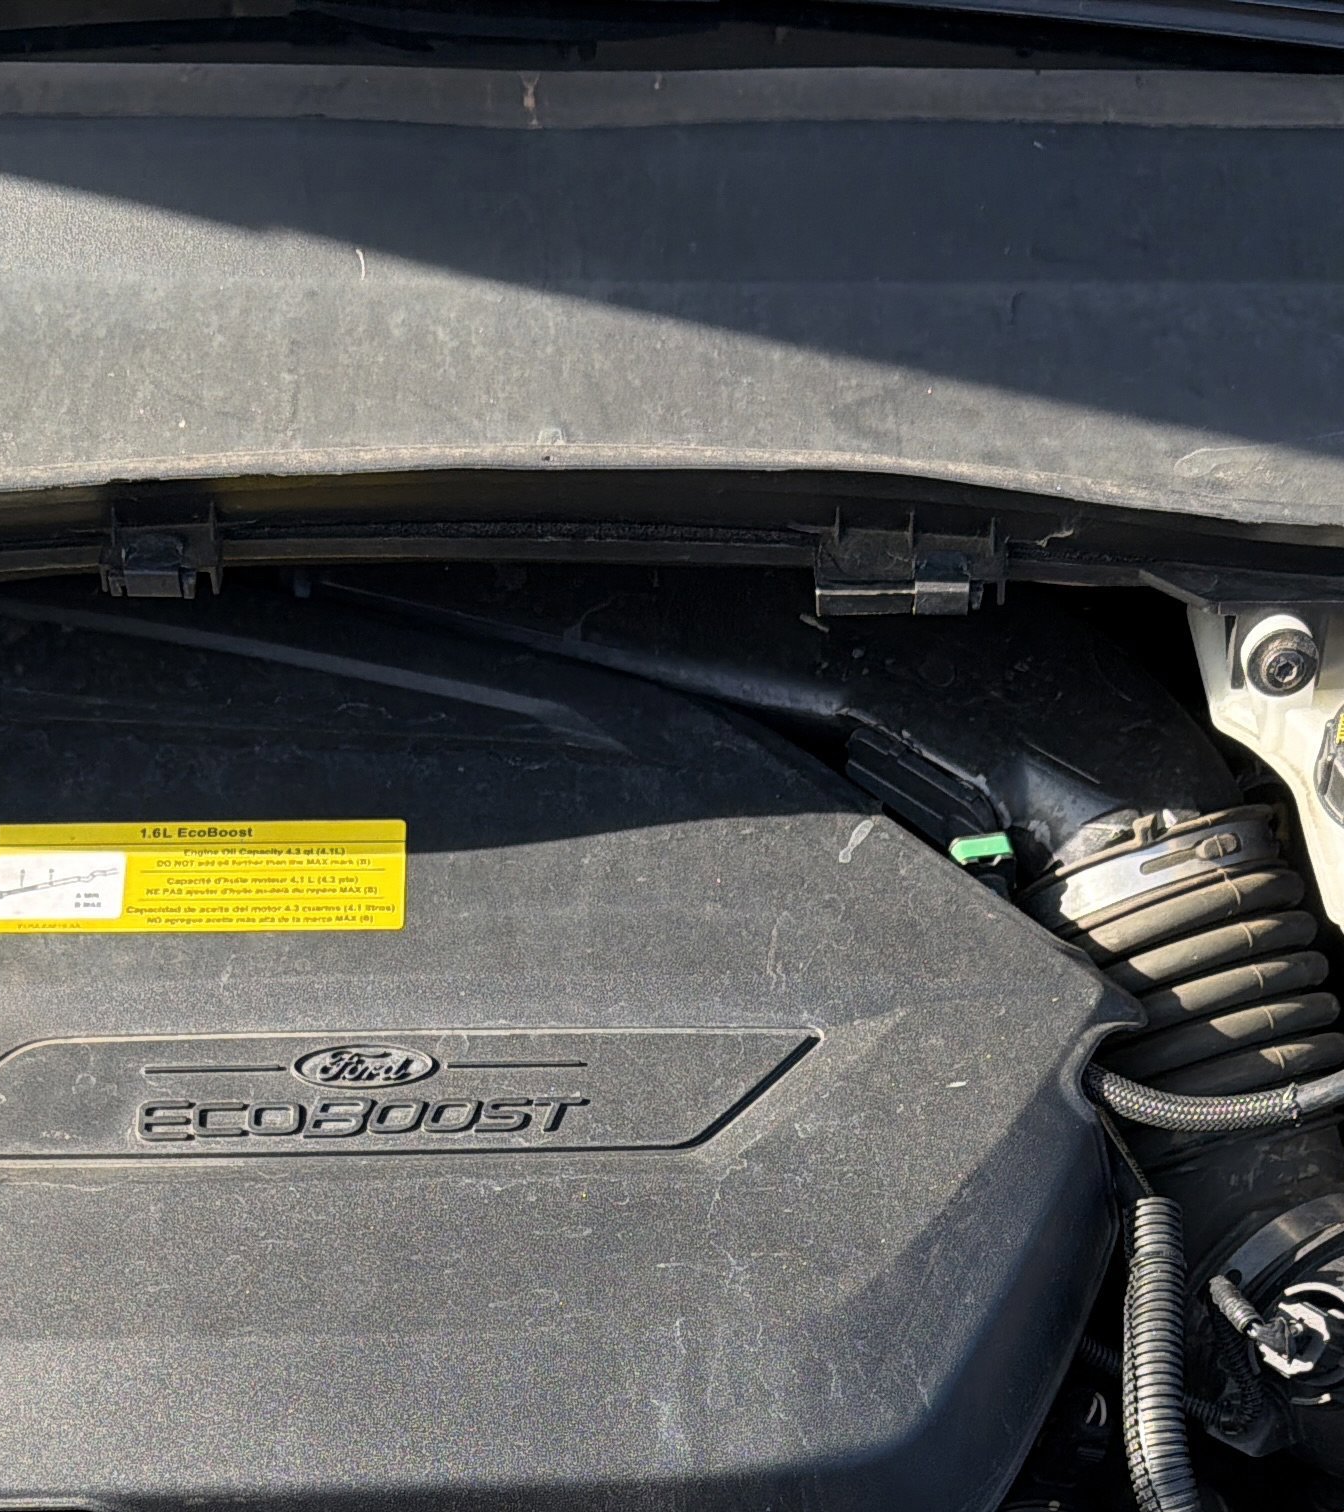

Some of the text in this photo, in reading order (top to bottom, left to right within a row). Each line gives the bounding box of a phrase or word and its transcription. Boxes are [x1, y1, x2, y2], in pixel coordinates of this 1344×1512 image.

[140, 826, 254, 840] 1.6L EcoBoost
[184, 848, 219, 857] Engine
[239, 848, 283, 856] Capacity
[198, 859, 215, 867] add
[331, 858, 354, 866] mark
[251, 877, 287, 885] moteur
[146, 888, 160, 896] NE
[163, 888, 182, 896] PAS
[126, 905, 182, 915] Capacidad
[184, 905, 197, 913] de
[232, 905, 249, 913] del
[251, 905, 282, 913] motor
[147, 916, 162, 924] NO
[164, 917, 204, 925] agregue
[335, 915, 357, 923] MAX
[316, 1050, 413, 1085] Ford
